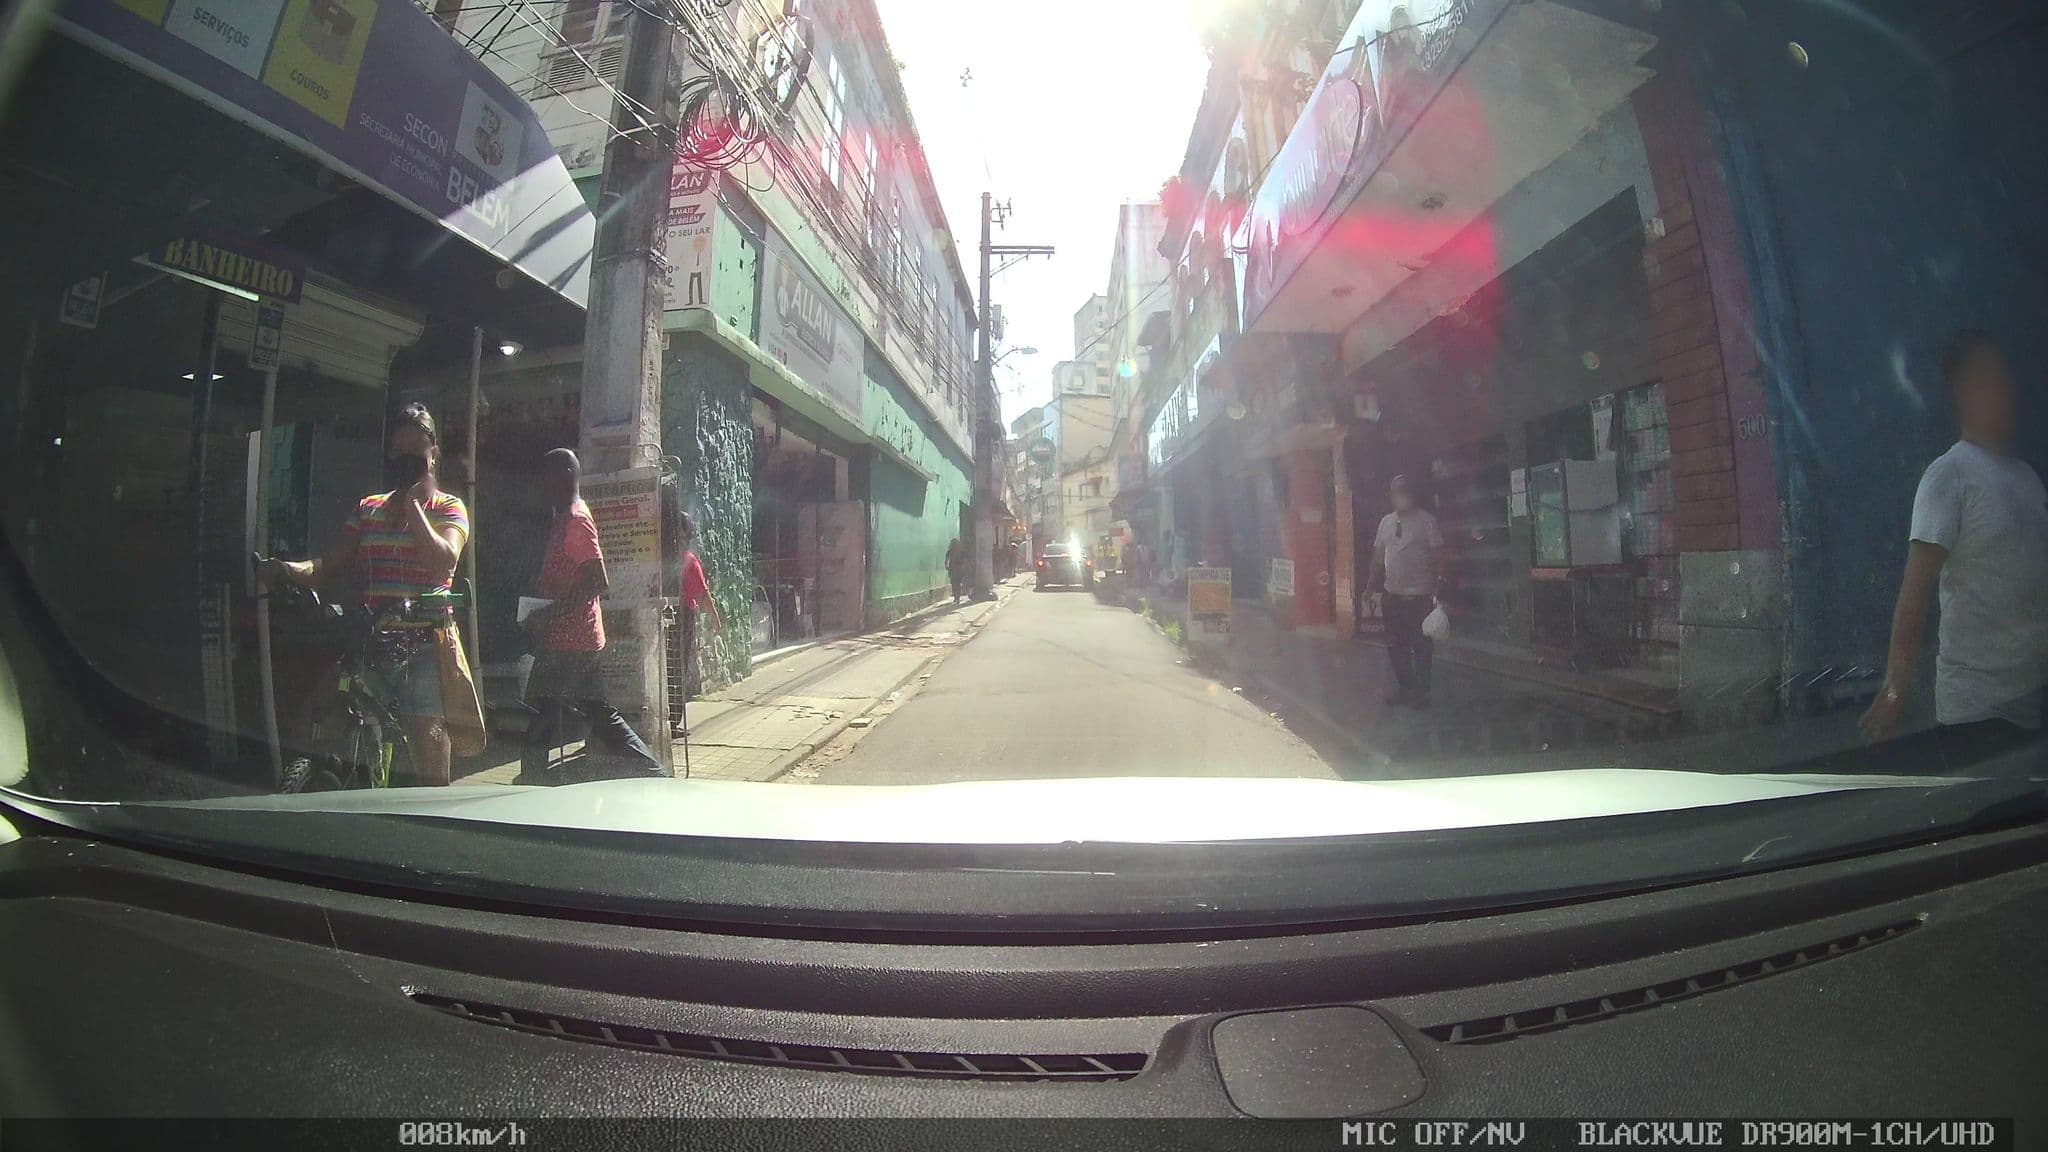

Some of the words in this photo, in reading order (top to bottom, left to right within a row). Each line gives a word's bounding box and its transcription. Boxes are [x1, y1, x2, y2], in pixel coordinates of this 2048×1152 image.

[193, 7, 250, 48] SERVIÇOS
[290, 70, 329, 100] COUROS
[359, 112, 405, 150] SECRETARIA
[403, 113, 450, 158] SECON
[390, 152, 402, 168] DE
[402, 157, 441, 193] ECONOMIA
[670, 172, 704, 190] LAN
[678, 229, 693, 237] SEU
[695, 227, 711, 235] LAR
[164, 237, 294, 297] BANHEIRO
[790, 279, 833, 344] ALLAN
